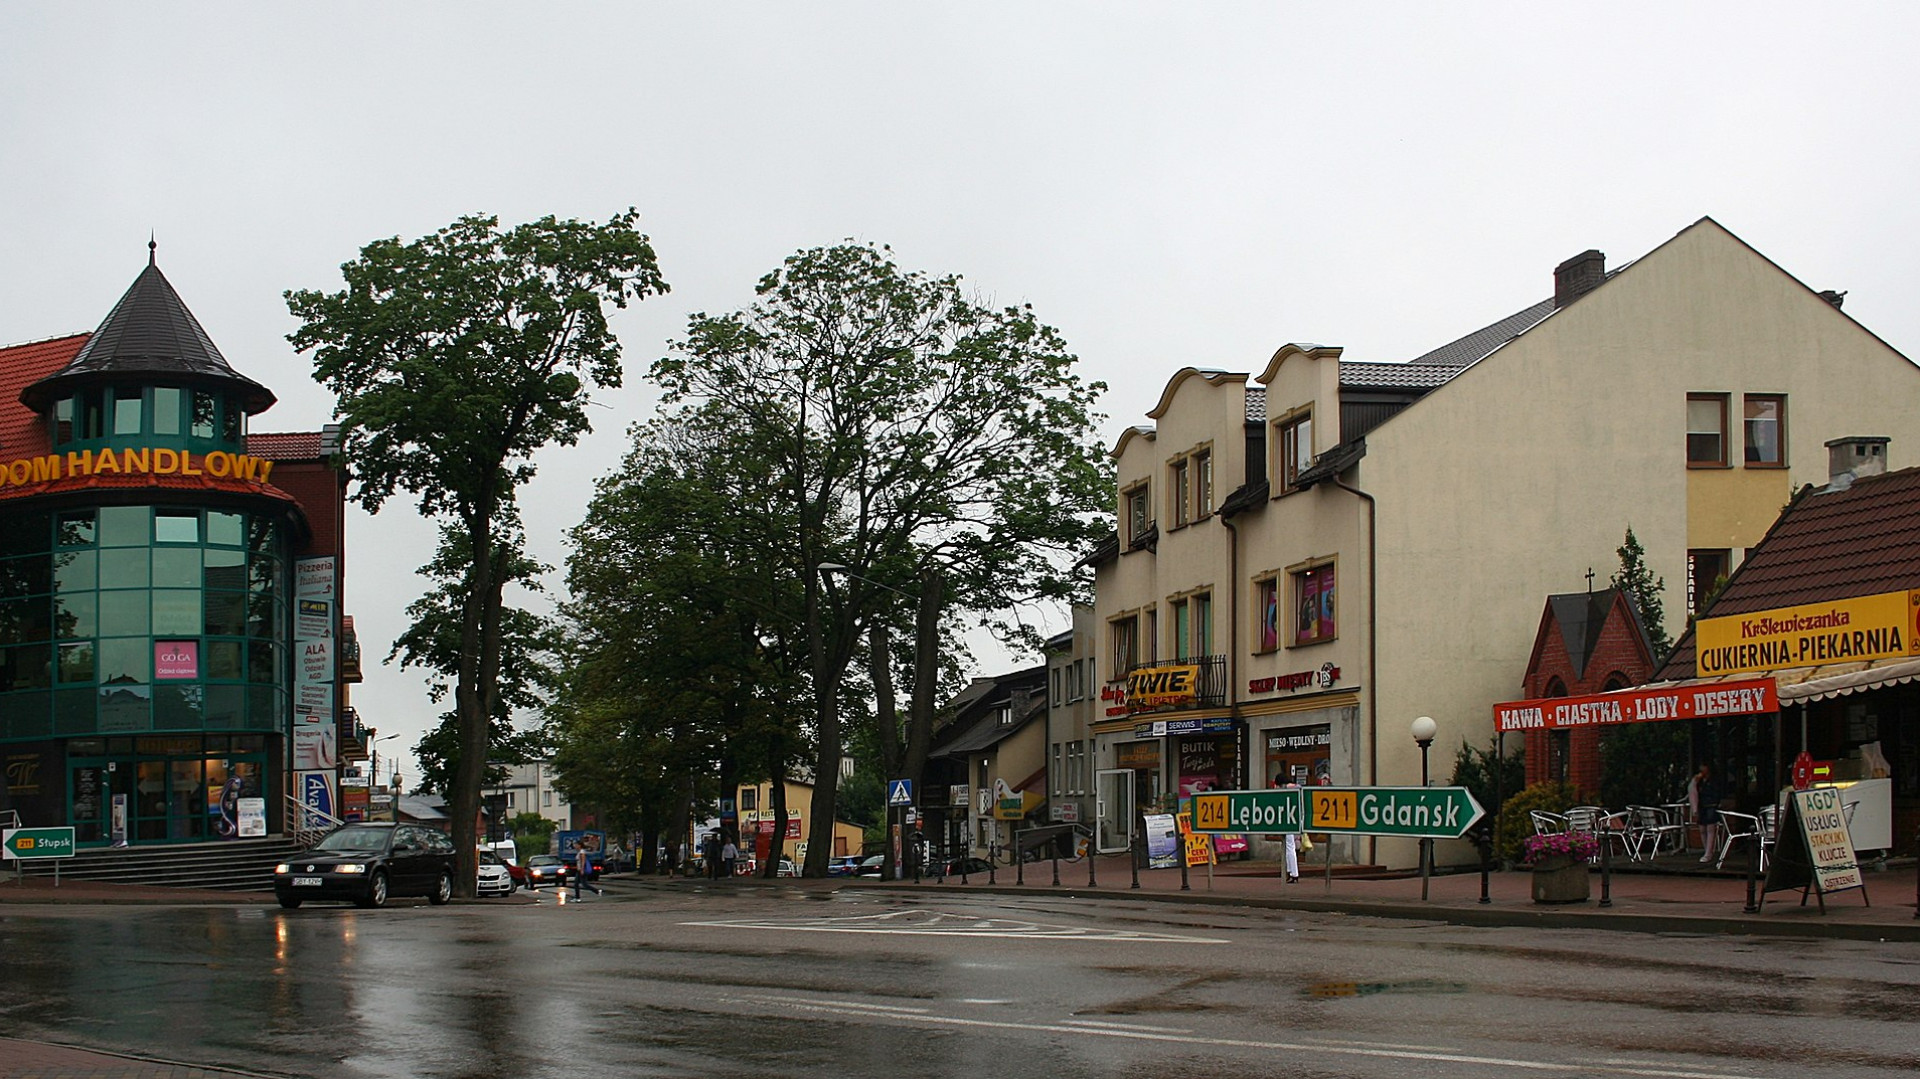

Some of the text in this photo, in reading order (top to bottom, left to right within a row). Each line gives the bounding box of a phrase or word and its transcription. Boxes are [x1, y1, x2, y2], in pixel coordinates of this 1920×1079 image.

[68, 448, 274, 484] HANDLOWY
[1687, 555, 1695, 616] SOLARIUM
[1741, 609, 1850, 639] Królewiczanka
[305, 643, 326, 656] ALA
[1501, 687, 1765, 730] KAWA CIASTKA LODY DESERY
[1169, 720, 1196, 730] SERWIS
[1182, 742, 1215, 754] BUTIK
[1289, 734, 1315, 749] WĘDLINY
[1806, 791, 1833, 812] AGD
[1201, 802, 1224, 823] 214
[1230, 797, 1298, 832] Lębork
[1320, 794, 1460, 828] 211 Gdańsk
[1805, 813, 1842, 832] USŁUGI
[38, 837, 71, 849] Słupsk
[1810, 831, 1846, 848] STACYJKI
[1818, 847, 1847, 861] KLUCZE
[1824, 874, 1856, 888] OSTRZENIE
